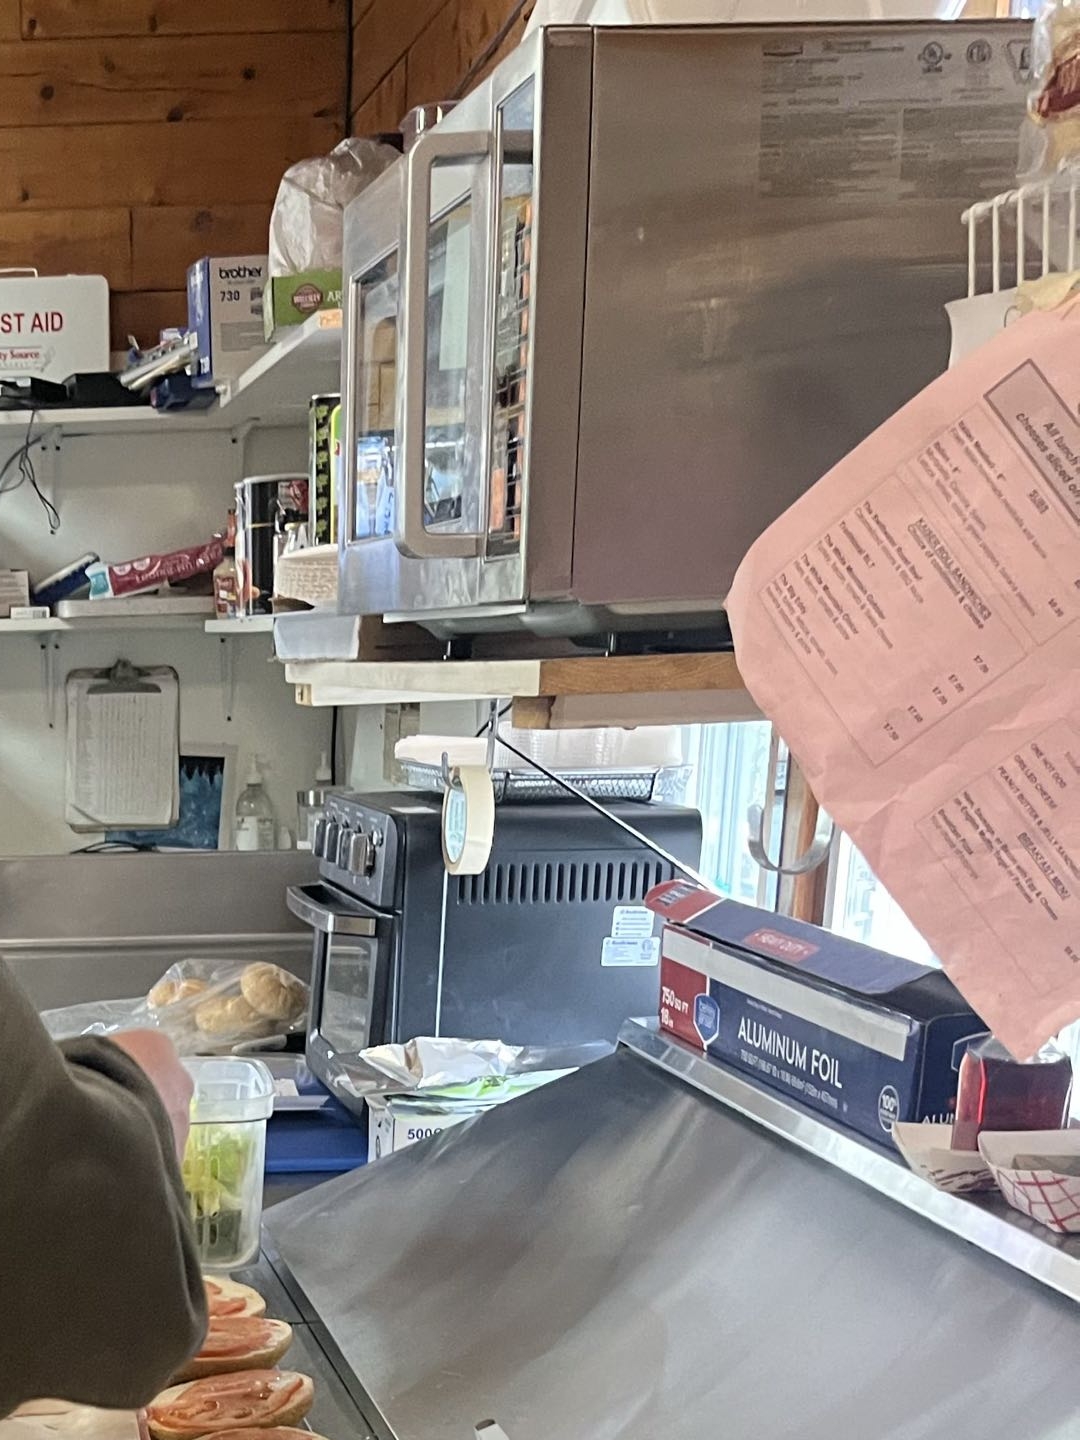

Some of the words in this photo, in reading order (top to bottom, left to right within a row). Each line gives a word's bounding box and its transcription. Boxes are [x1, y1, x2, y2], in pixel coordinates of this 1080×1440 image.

[218, 266, 262, 279] brother
[219, 290, 241, 302] 730
[30, 310, 64, 333] AID
[9, 348, 40, 360] Source
[1016, 411, 1049, 452] cheeses
[1045, 450, 1072, 483] sliced
[1044, 420, 1059, 437] All
[1054, 435, 1079, 465] lunch
[914, 518, 940, 549] KAISER
[934, 546, 955, 570] ROLL
[950, 567, 992, 620] SANDWICHES
[1013, 753, 1037, 784] GRILLED
[1034, 782, 1056, 809] CHEESE
[1029, 742, 1043, 758] ONE
[1041, 757, 1054, 772] HOT
[1051, 771, 1066, 788] DOG
[997, 765, 1019, 793] PEANUT
[1017, 793, 1038, 819] BUTTER
[1040, 825, 1058, 846] JELLY
[1017, 831, 1054, 878] BREAKFAST
[1049, 875, 1070, 900] MENU
[661, 1007, 669, 1025] 18
[662, 986, 675, 1008] 750
[737, 1015, 808, 1072] ALUMINUM
[810, 1048, 843, 1089] FOIL
